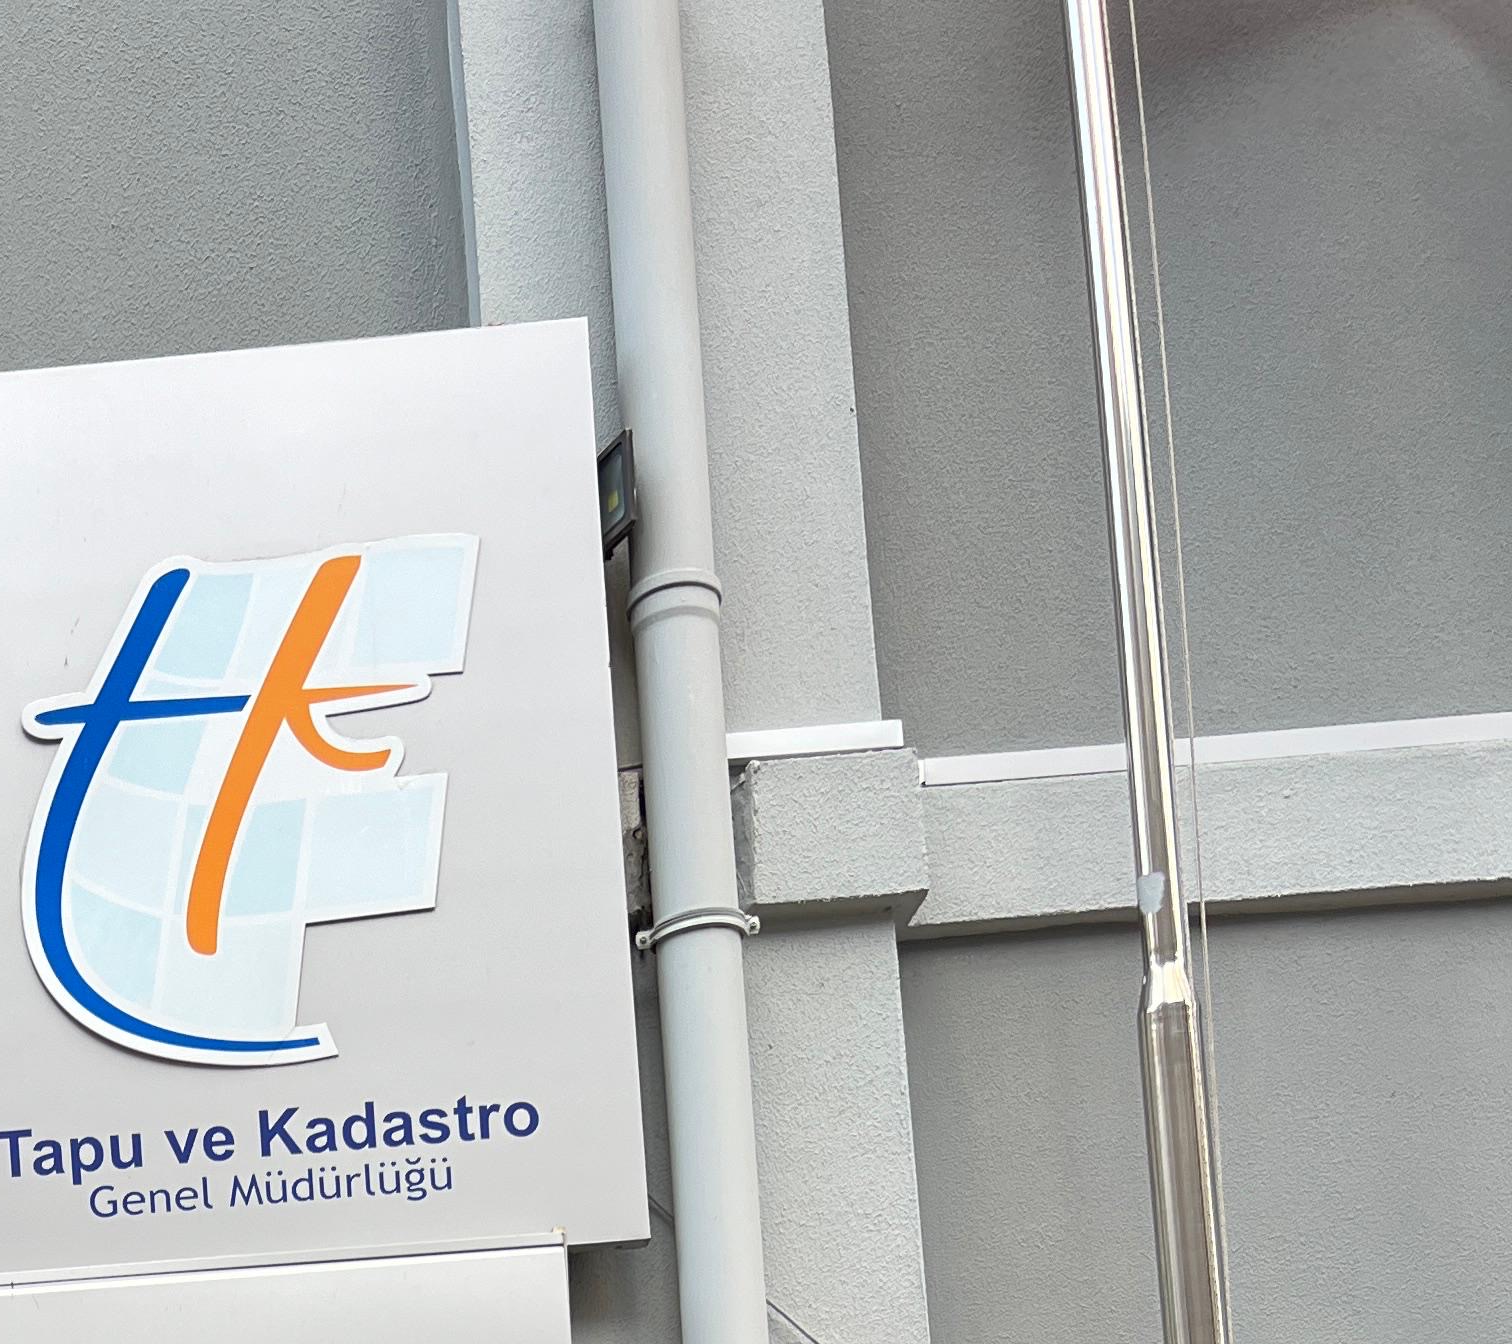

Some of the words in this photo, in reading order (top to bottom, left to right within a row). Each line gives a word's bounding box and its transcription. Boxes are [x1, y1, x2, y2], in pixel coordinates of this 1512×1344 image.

[165, 1124, 236, 1165] ve
[258, 1095, 541, 1158] Kadastro
[89, 1176, 214, 1218] Genel
[229, 1158, 454, 1208] Müdürlüğü
